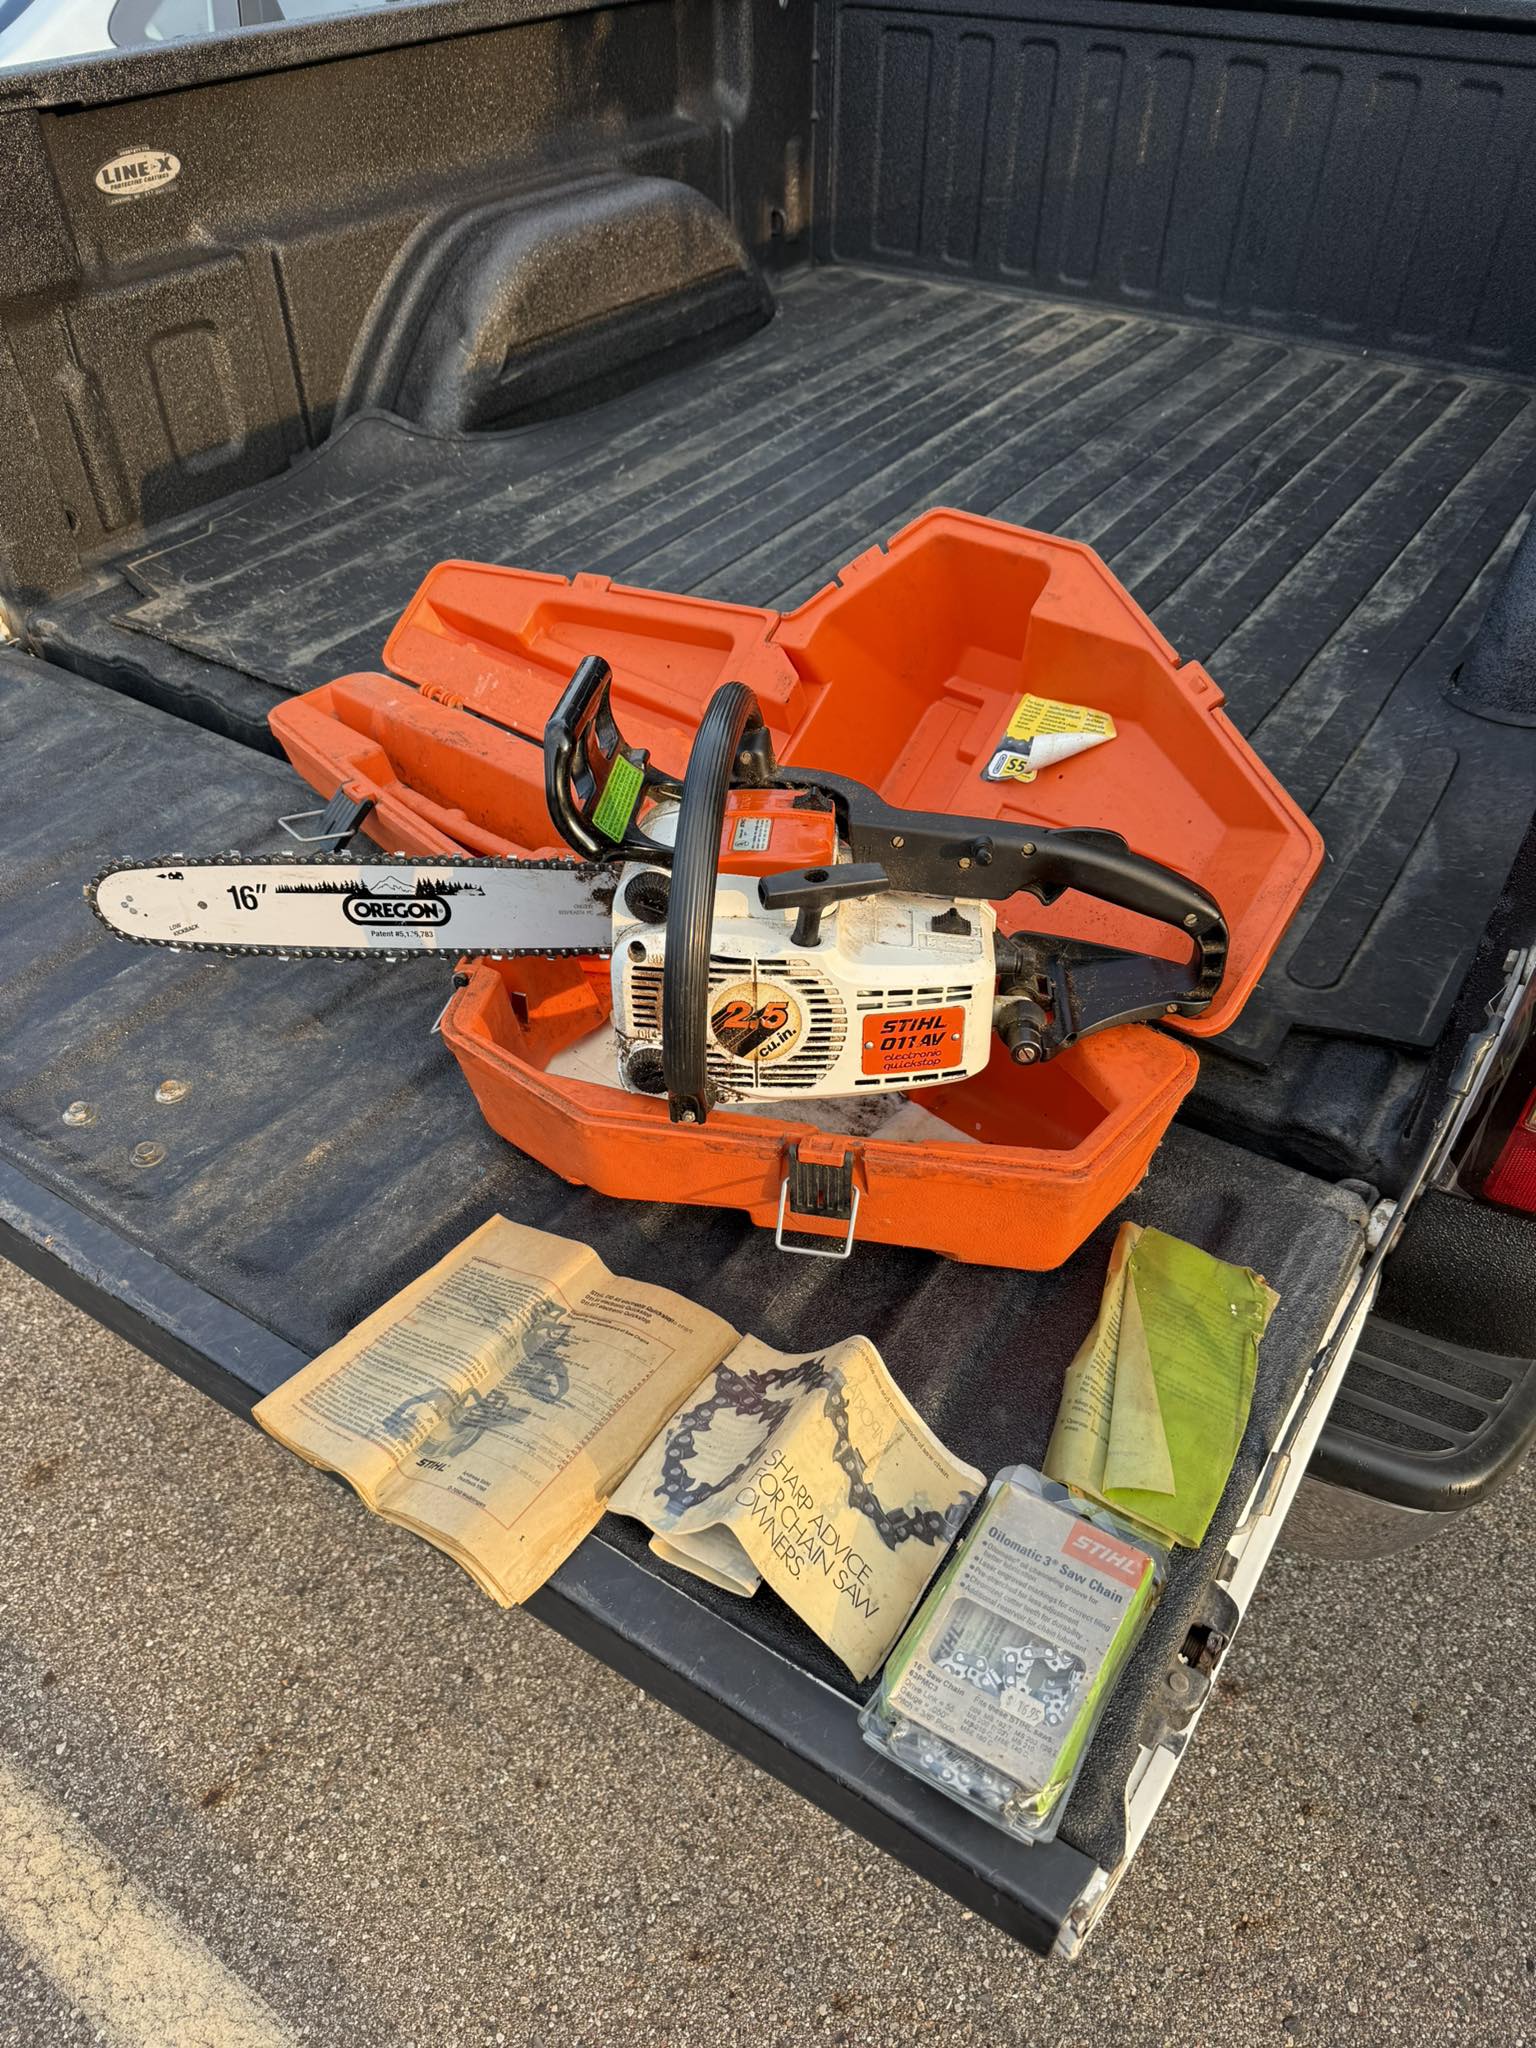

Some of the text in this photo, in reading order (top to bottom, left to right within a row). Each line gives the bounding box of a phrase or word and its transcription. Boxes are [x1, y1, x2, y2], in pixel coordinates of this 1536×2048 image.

[227, 883, 267, 911] 16"
[724, 1000, 789, 1030] 2.5
[880, 1015, 948, 1034] STIHL
[880, 1036, 917, 1051] 011
[884, 1049, 942, 1061] electronic
[883, 1058, 942, 1071] quickstop
[416, 1458, 448, 1472] STIHL
[735, 1487, 805, 1581] OWNERS.
[764, 1449, 873, 1586] SHARP ADVICE
[749, 1467, 880, 1618] FOR CHAIN SAW
[1072, 1535, 1137, 1576] STIHL
[982, 1549, 1037, 1582] better lubrication
[987, 1525, 1044, 1562] Oilomatic
[1058, 1563, 1086, 1584] Saw
[1088, 1578, 1124, 1604] Chain
[1019, 1560, 1029, 1569] oil
[1028, 1565, 1064, 1589] channeling
[1064, 1584, 1087, 1600] groove
[1088, 1595, 1098, 1605] for
[978, 1558, 1111, 1632] Laser engraved markings for correct filing
[1017, 1589, 1028, 1599] for
[1028, 1595, 1042, 1607] less
[1042, 1603, 1079, 1627] adjustment
[963, 1583, 1087, 1653] Additional reservoir for chain lubricant
[1003, 1593, 1022, 1607] cutter
[1022, 1603, 1040, 1617] teeth
[1040, 1613, 1051, 1623] for
[1049, 1618, 1083, 1641] durability
[898, 1685, 924, 1706] Gauge
[902, 1678, 923, 1694] Drive
[922, 1689, 939, 1703] Link
[912, 1660, 966, 1697] 16" Saw Chain
[972, 1695, 987, 1708] Fits
[986, 1704, 1007, 1719] these
[1008, 1714, 1033, 1732] STIHL
